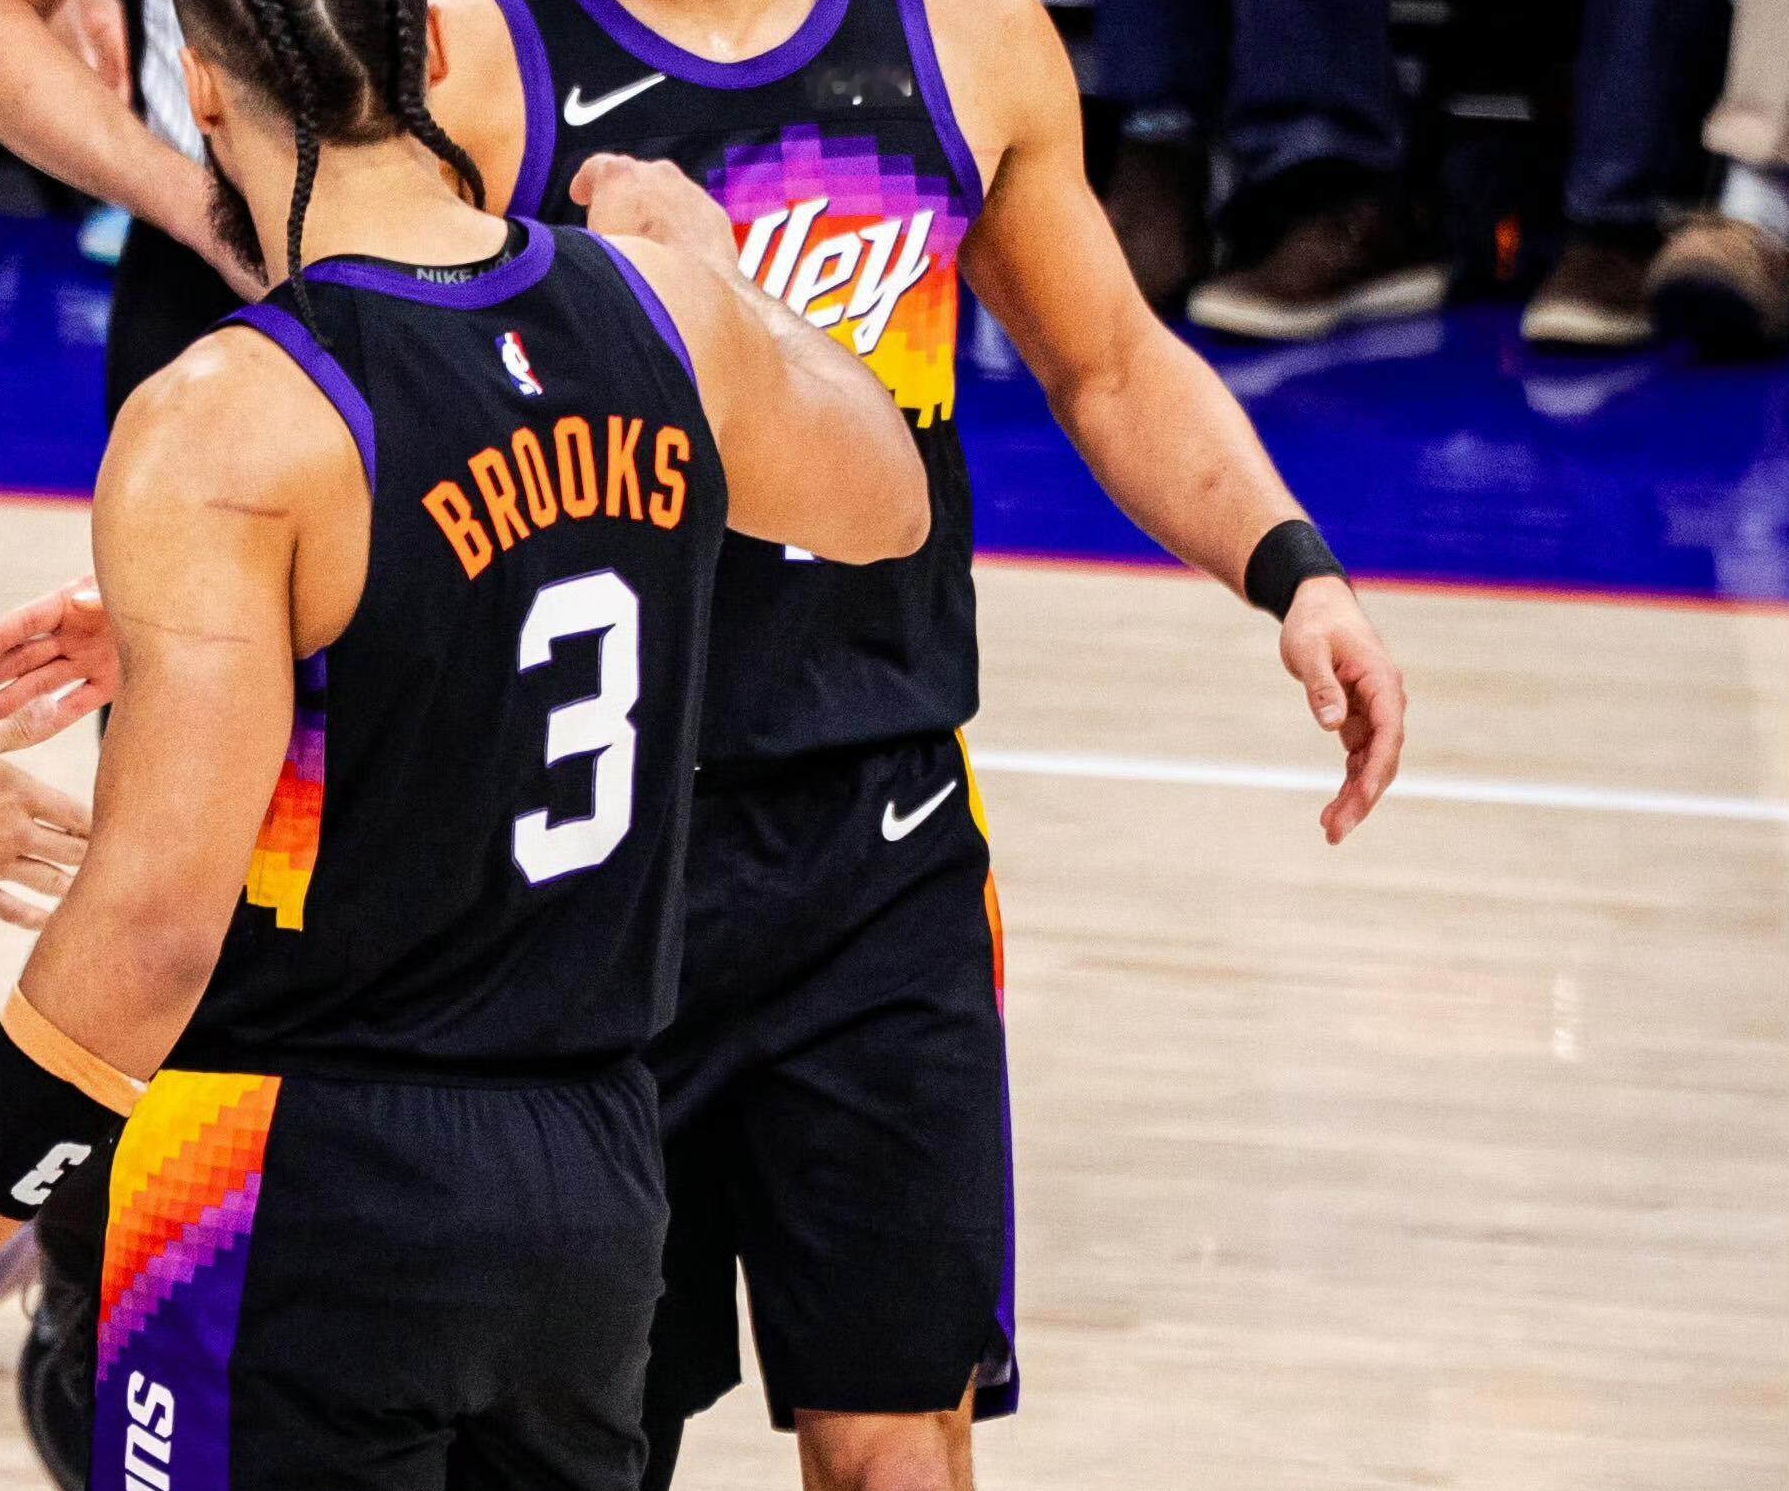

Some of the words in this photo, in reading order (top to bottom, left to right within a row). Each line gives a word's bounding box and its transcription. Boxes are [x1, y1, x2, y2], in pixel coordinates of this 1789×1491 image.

[416, 268, 471, 285] NIKE
[737, 197, 934, 356] lley
[422, 414, 691, 580] BROOKS
[513, 566, 641, 887] 3
